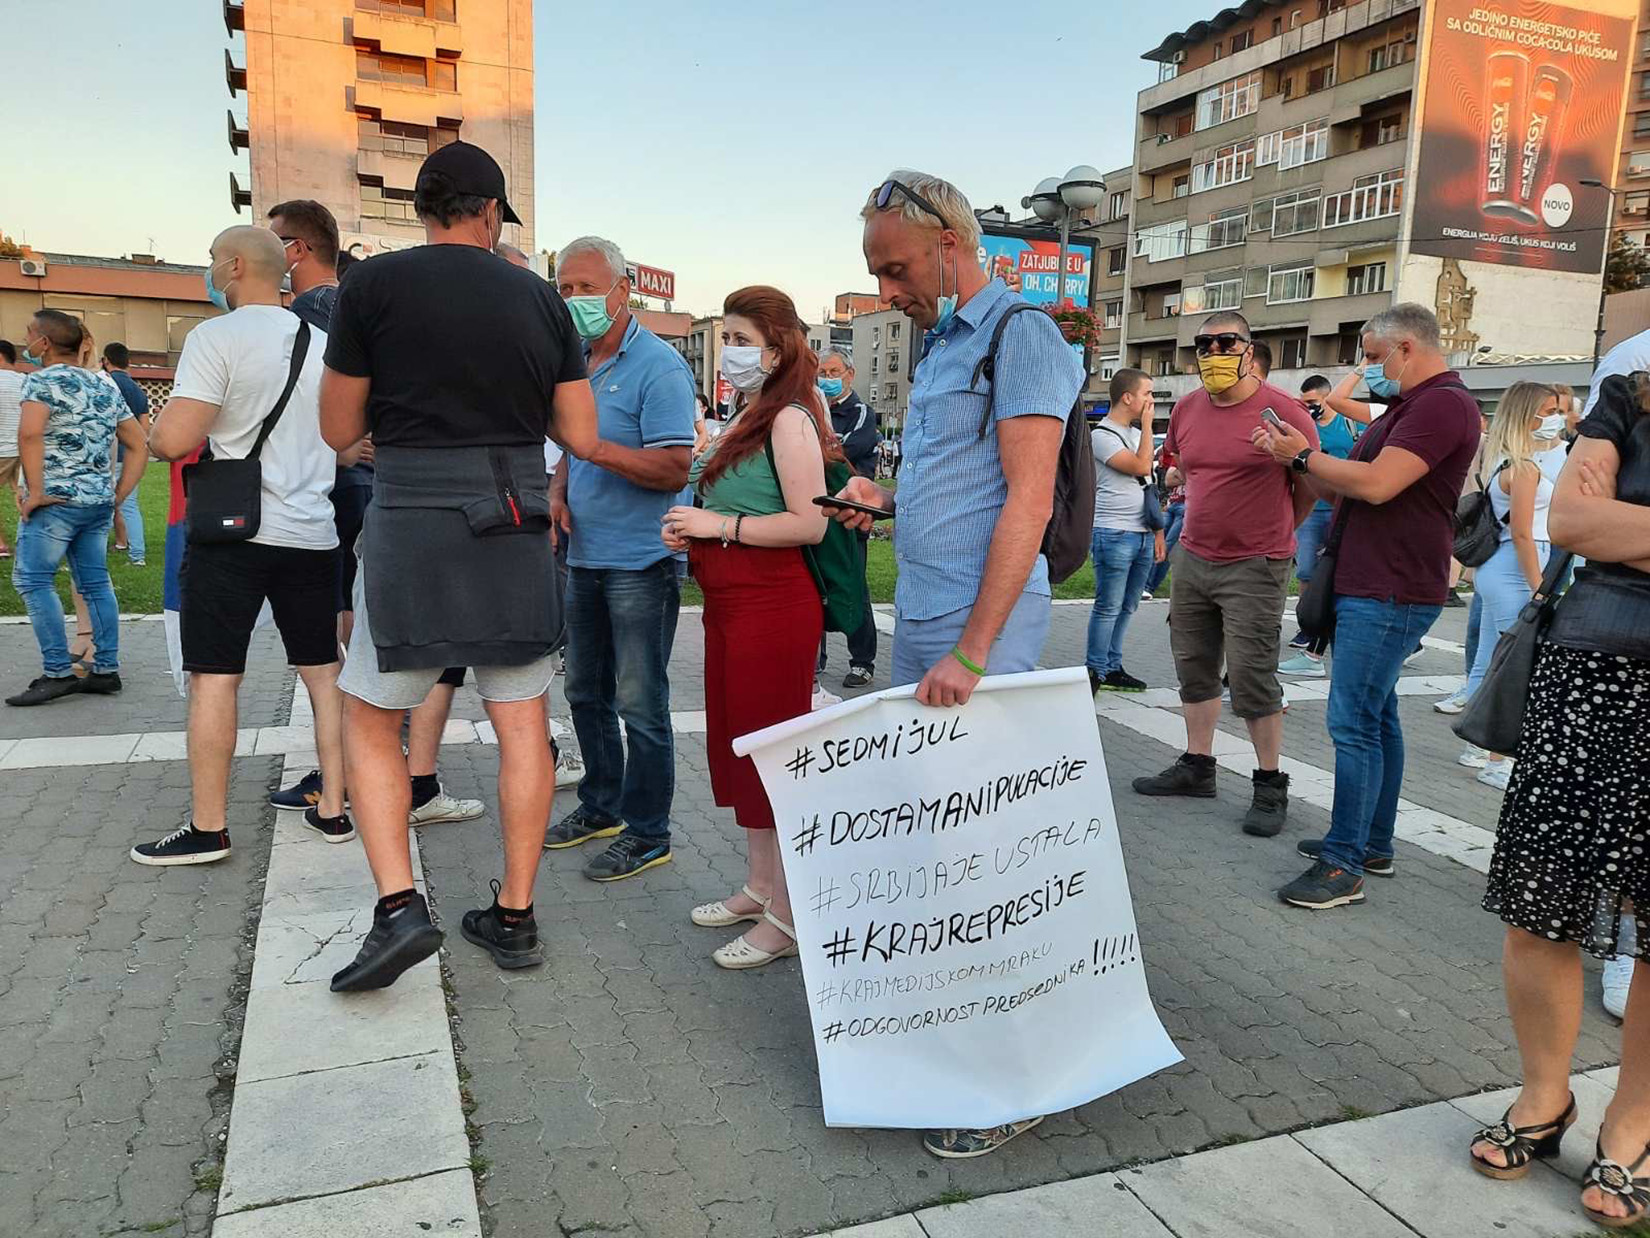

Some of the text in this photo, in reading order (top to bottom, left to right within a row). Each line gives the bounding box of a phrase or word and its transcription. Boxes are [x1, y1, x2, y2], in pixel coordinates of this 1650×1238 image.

[1469, 8, 1508, 26] JEDINO
[1510, 16, 1577, 39] ENERGETSKO
[1447, 17, 1461, 31] SA
[1574, 44, 1618, 61] UKUSOM
[1488, 103, 1505, 193] ENERGY
[1543, 199, 1570, 212] NOVO
[1022, 254, 1082, 271] ZATJUBIE U
[640, 270, 671, 295] MAXI
[1025, 274, 1084, 295] OH, CHRRY
